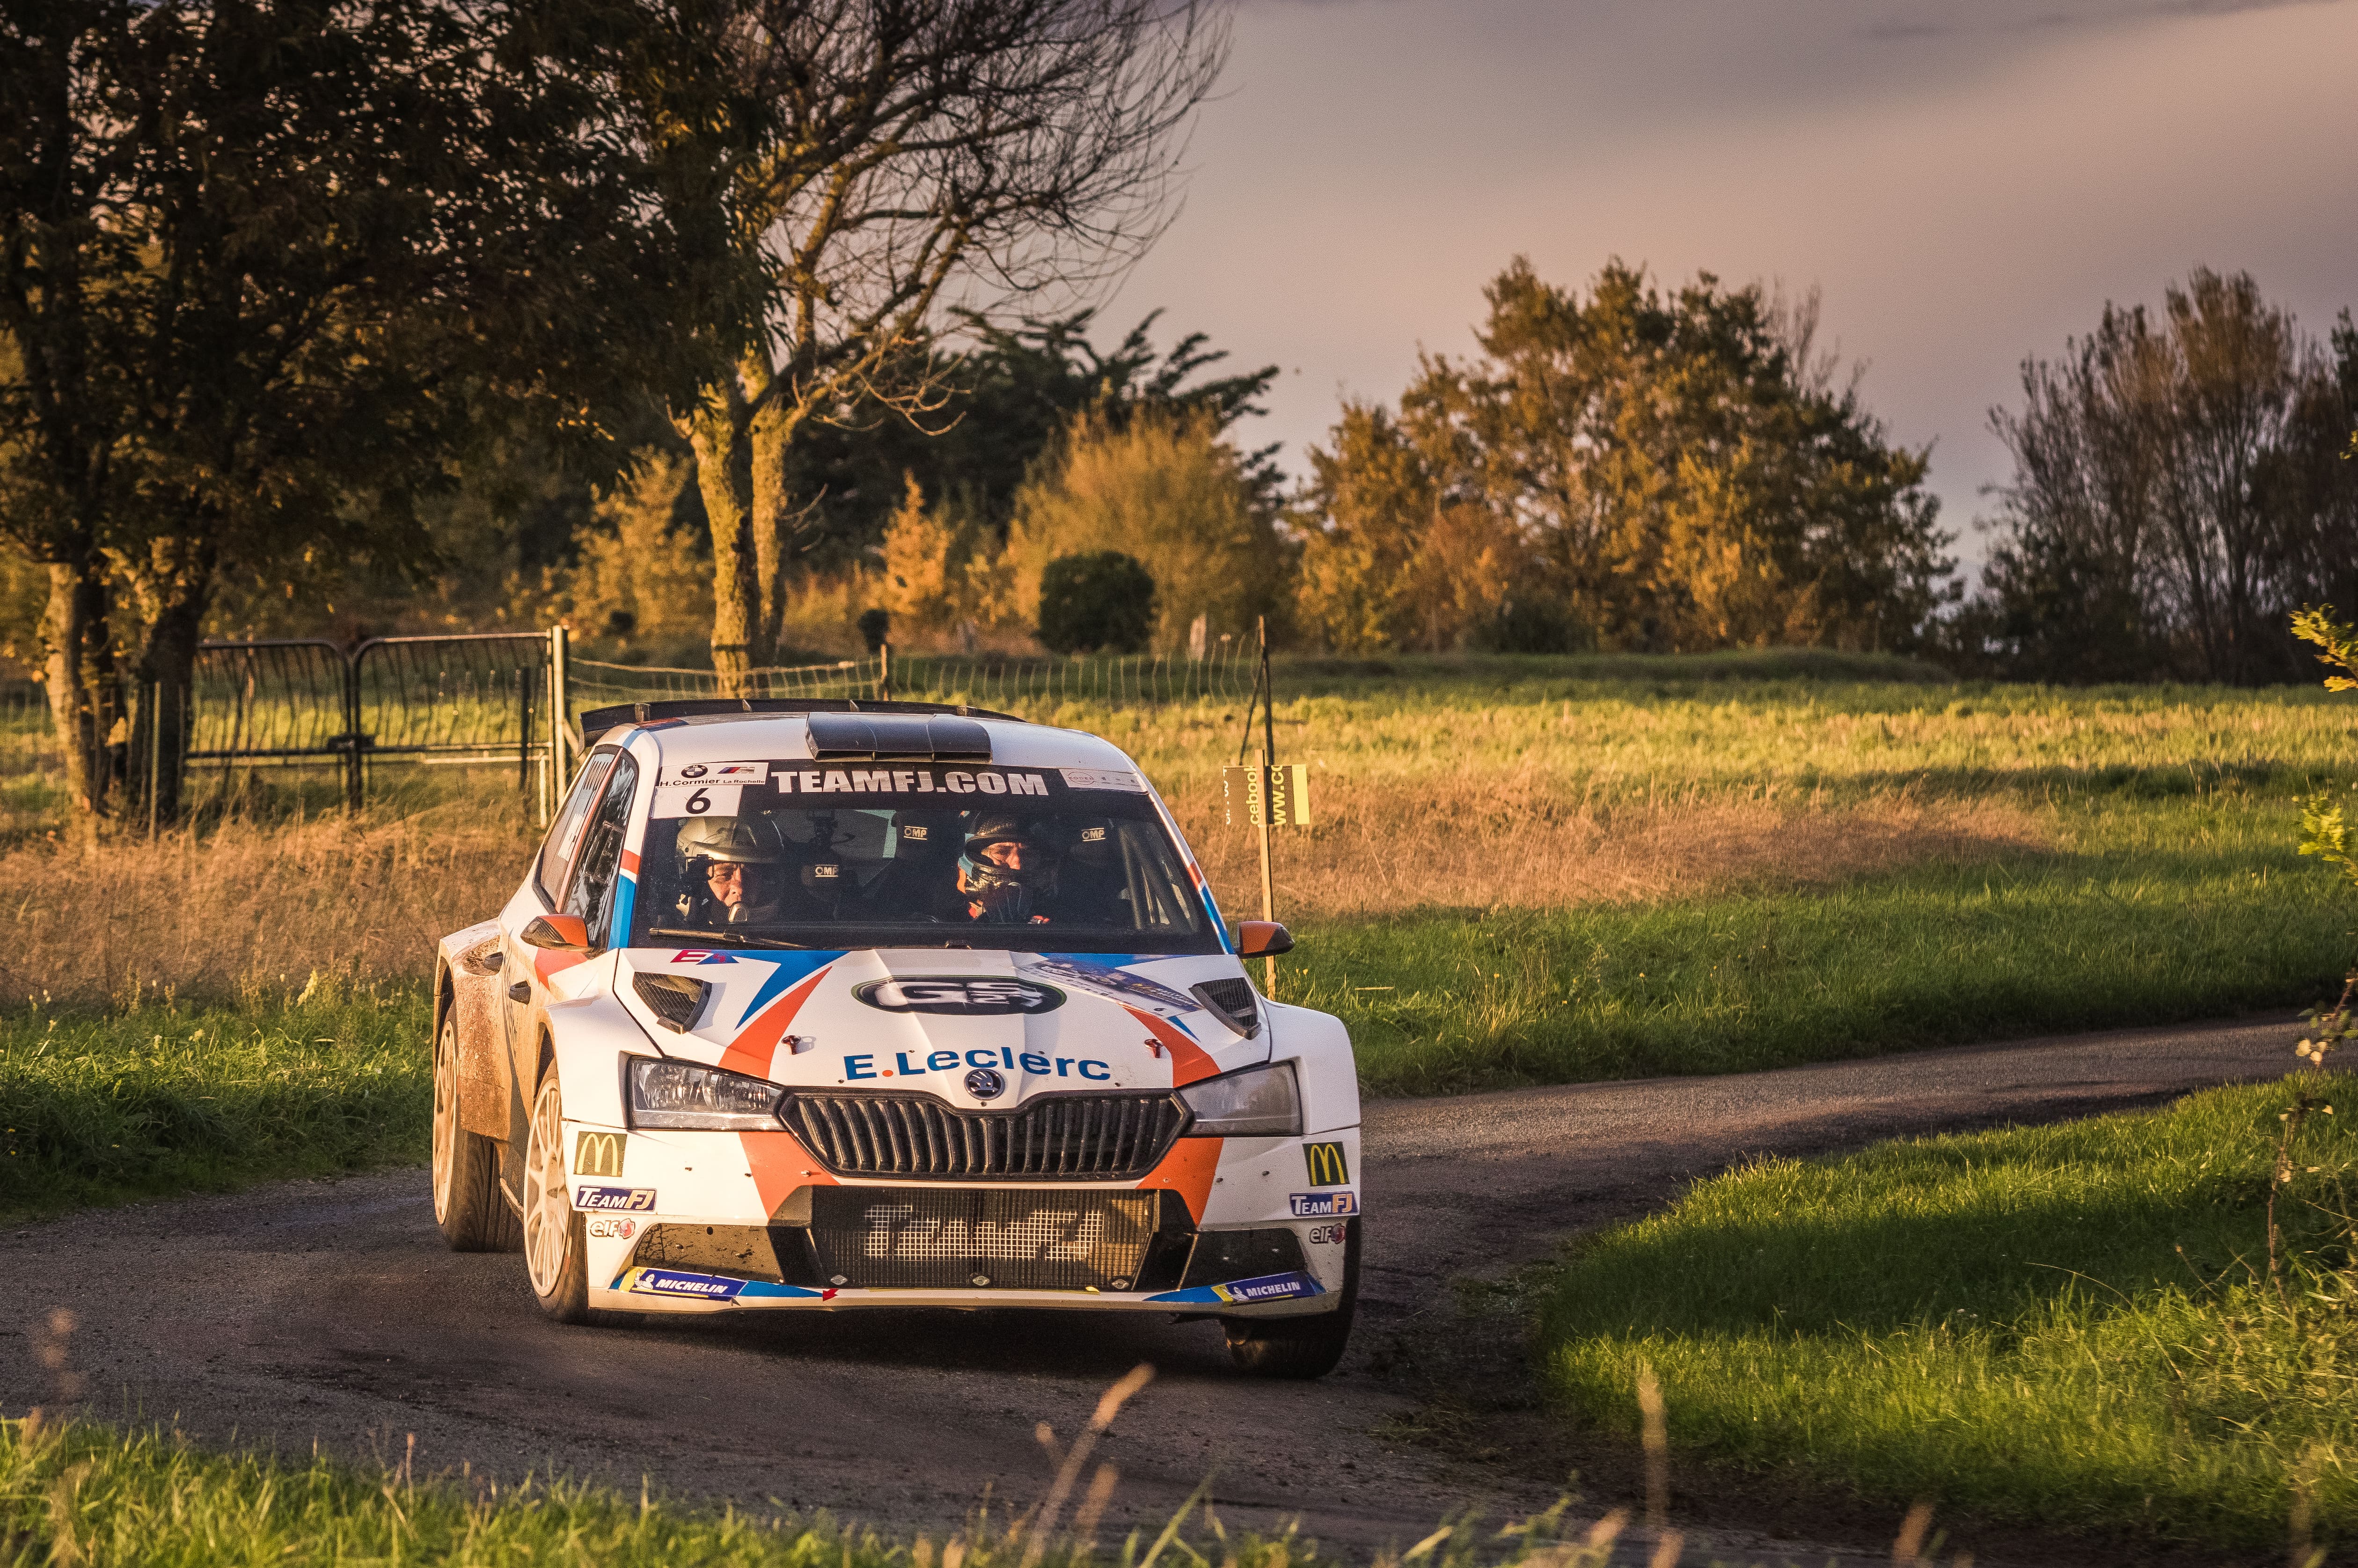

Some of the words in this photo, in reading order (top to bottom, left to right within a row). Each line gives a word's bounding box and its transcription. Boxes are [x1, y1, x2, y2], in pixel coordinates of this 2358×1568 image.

[660, 778, 721, 787] H.Cormier
[771, 770, 1049, 796] TEAMFJ.COM
[685, 787, 711, 814] 6
[904, 827, 927, 838] OMP
[1082, 829, 1105, 840] OMP
[815, 866, 838, 875] OMP
[843, 1047, 1111, 1080] E.Leclerc
[590, 1220, 620, 1237] elf
[1310, 1227, 1332, 1244] elf
[656, 1278, 728, 1295] MICHELIN
[1246, 1281, 1301, 1297] MICHELIN
